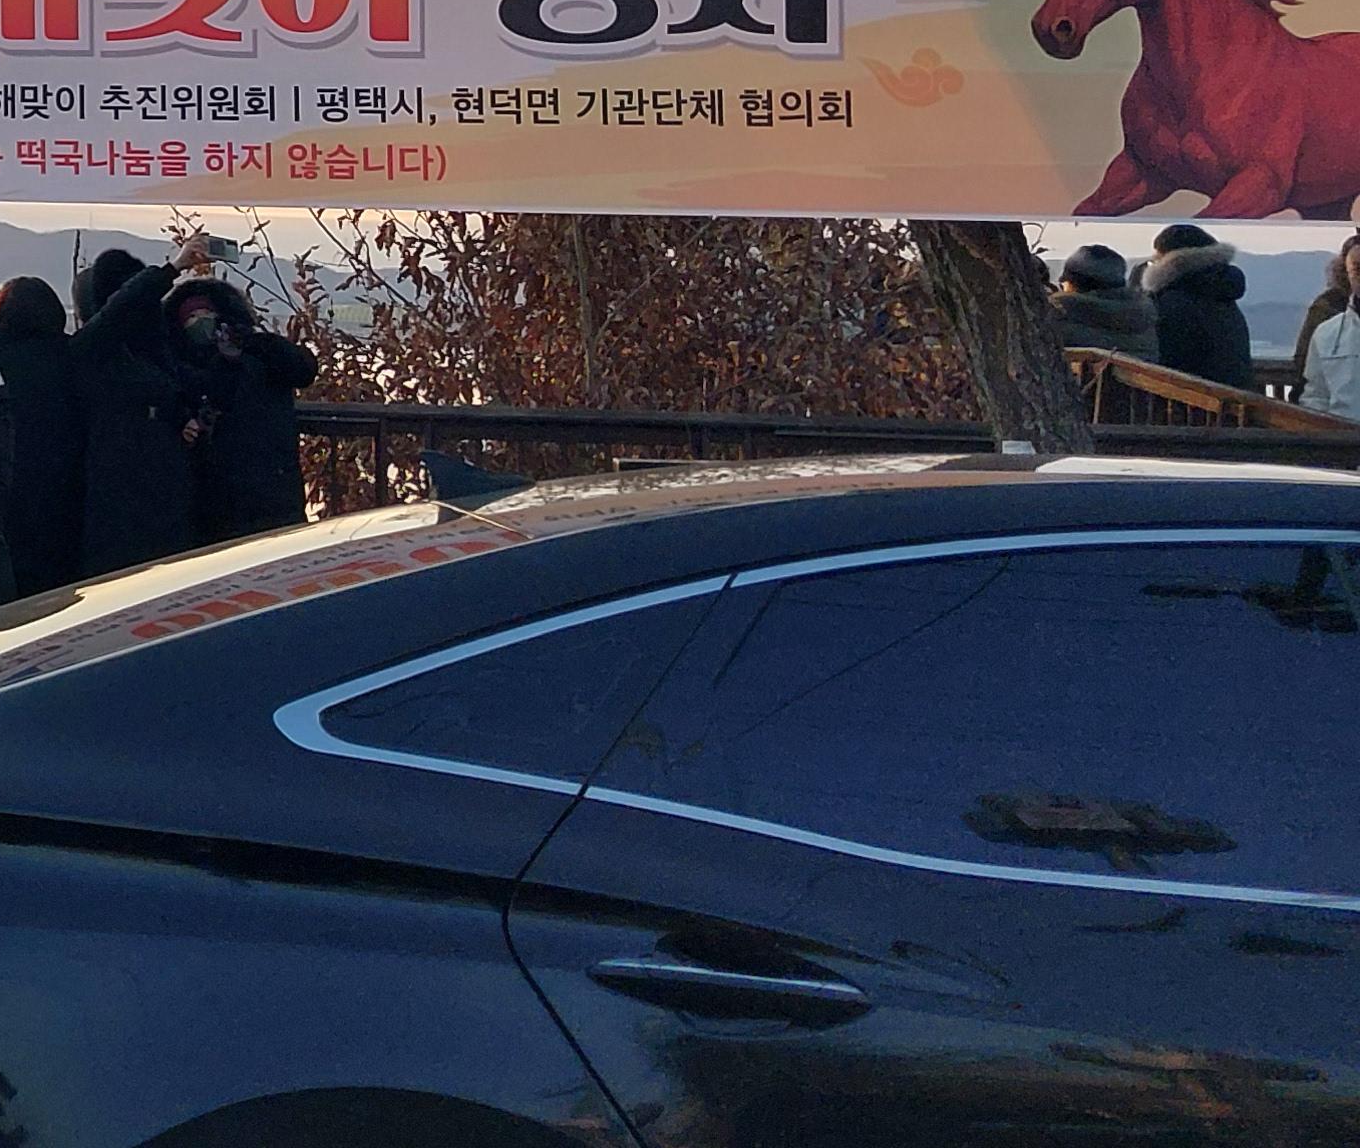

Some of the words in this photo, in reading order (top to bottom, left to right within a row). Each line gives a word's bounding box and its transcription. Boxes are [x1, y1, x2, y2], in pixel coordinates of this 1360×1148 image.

[99, 84, 276, 122] 추진위원회
[316, 85, 437, 126] 평택시,
[451, 85, 561, 126] 현덕면
[576, 87, 725, 127] 기관단체
[739, 88, 854, 128] 협의회
[16, 138, 191, 177] 떡국나눔을
[203, 141, 272, 178] 하지
[287, 142, 447, 181] 않습니다)
